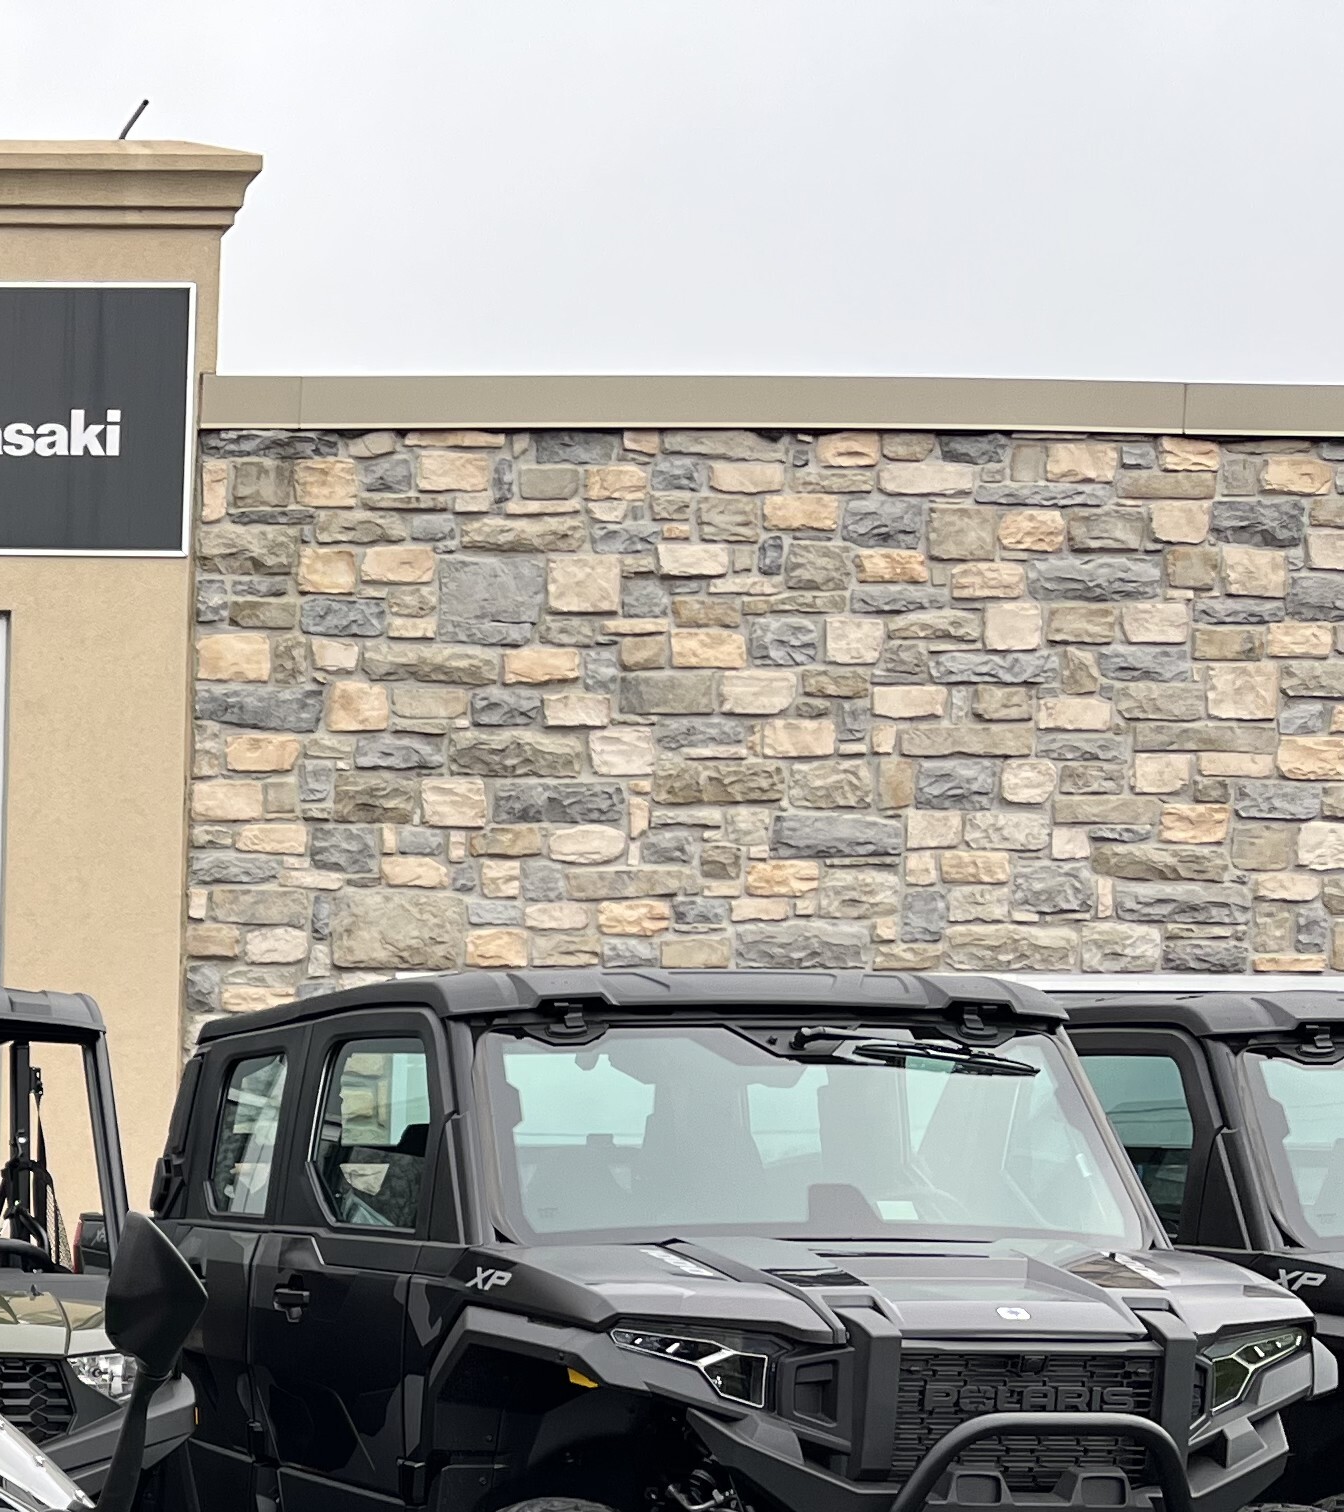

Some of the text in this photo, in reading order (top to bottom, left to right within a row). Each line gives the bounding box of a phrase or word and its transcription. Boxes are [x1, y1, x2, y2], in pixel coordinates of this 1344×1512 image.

[465, 1266, 513, 1291] XP
[1273, 1268, 1327, 1292] XP
[925, 1385, 1135, 1412] POLARIS
